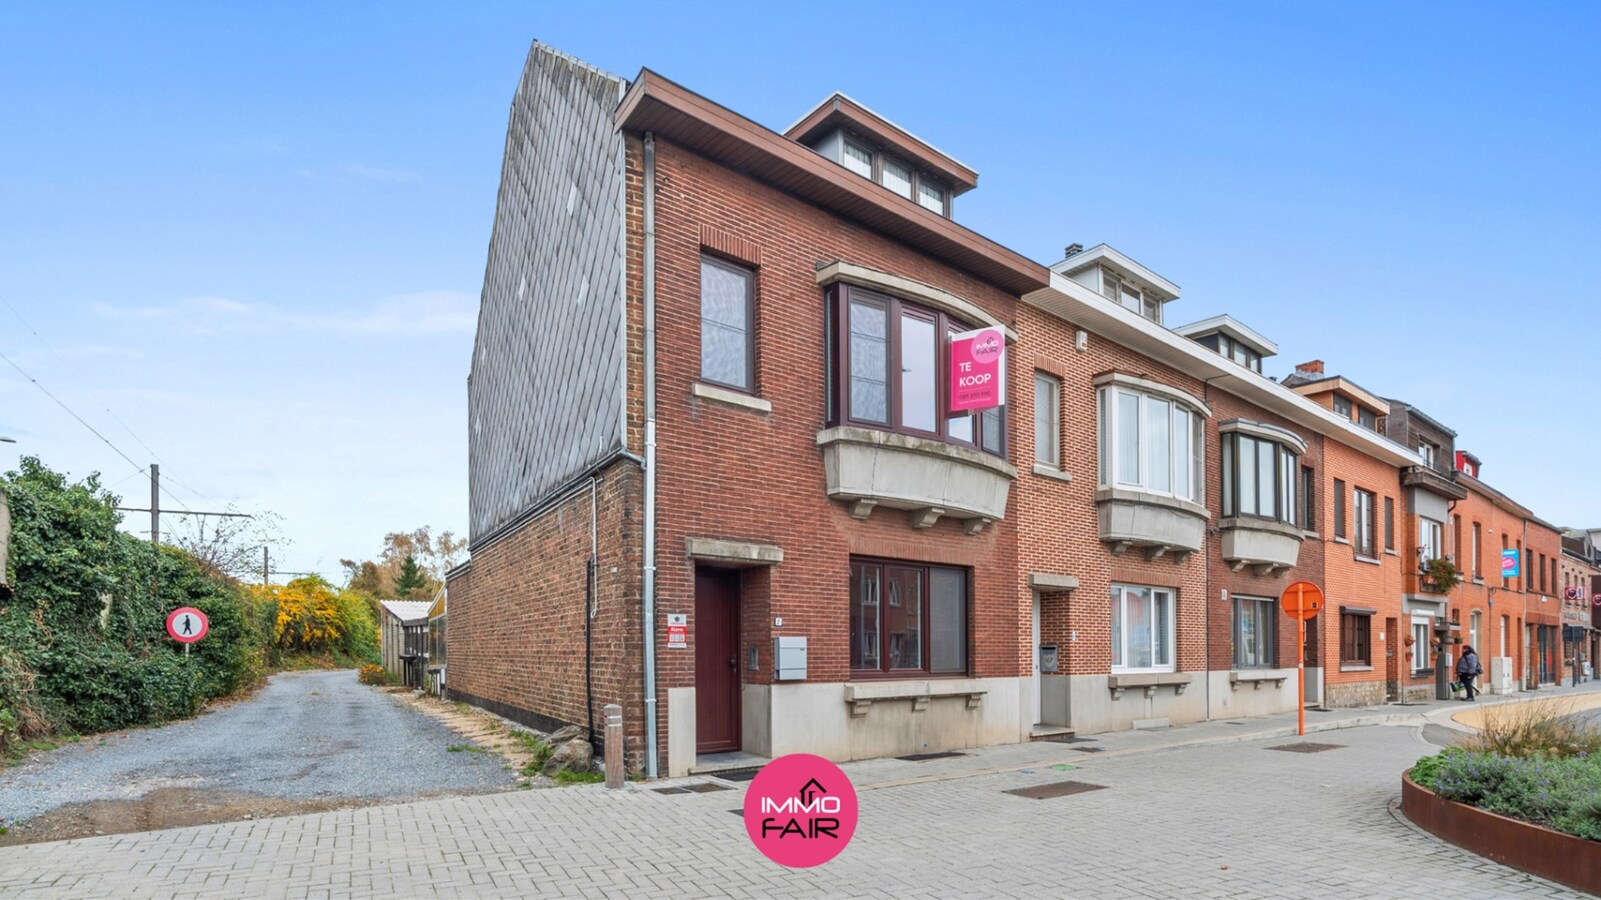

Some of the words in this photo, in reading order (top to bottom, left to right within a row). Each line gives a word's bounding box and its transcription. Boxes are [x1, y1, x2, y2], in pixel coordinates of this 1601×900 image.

[976, 346, 999, 356] FAIR
[959, 361, 972, 373] TE
[959, 373, 992, 387] KOOP
